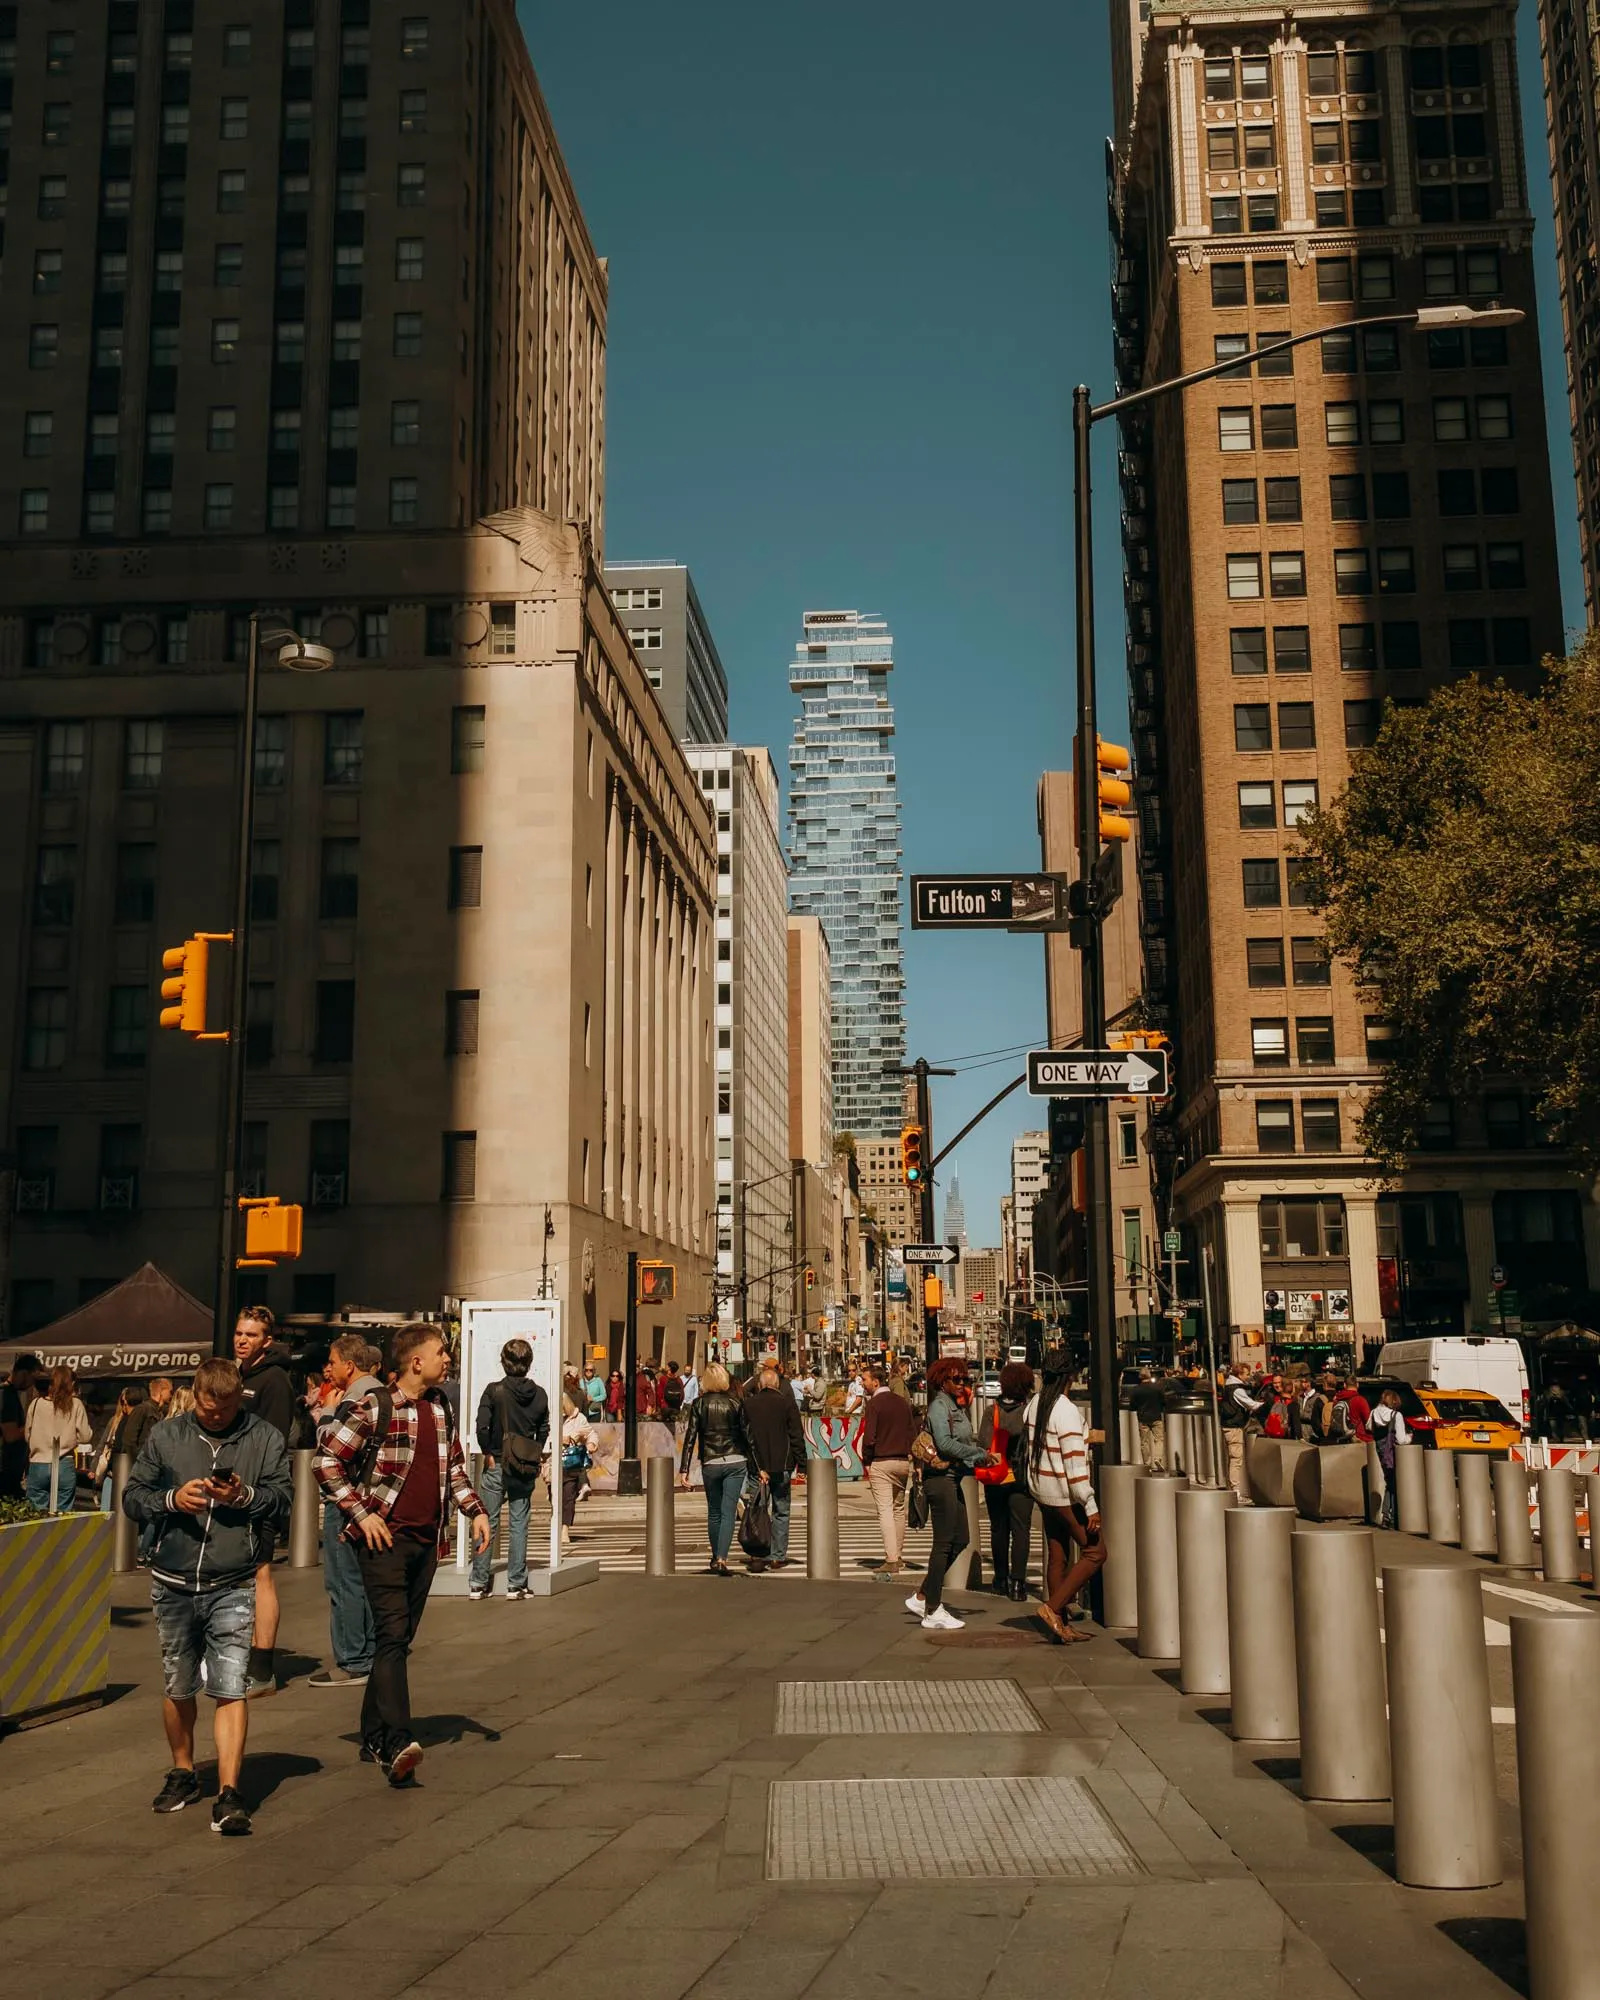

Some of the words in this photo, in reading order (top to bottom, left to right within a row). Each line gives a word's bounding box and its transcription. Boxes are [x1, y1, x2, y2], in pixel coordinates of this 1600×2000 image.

[928, 889, 985, 914] Fulton
[991, 889, 1001, 902] St
[1042, 1065, 1078, 1081] ONE
[1085, 1065, 1123, 1081] WAY
[109, 1348, 200, 1371] Supreme
